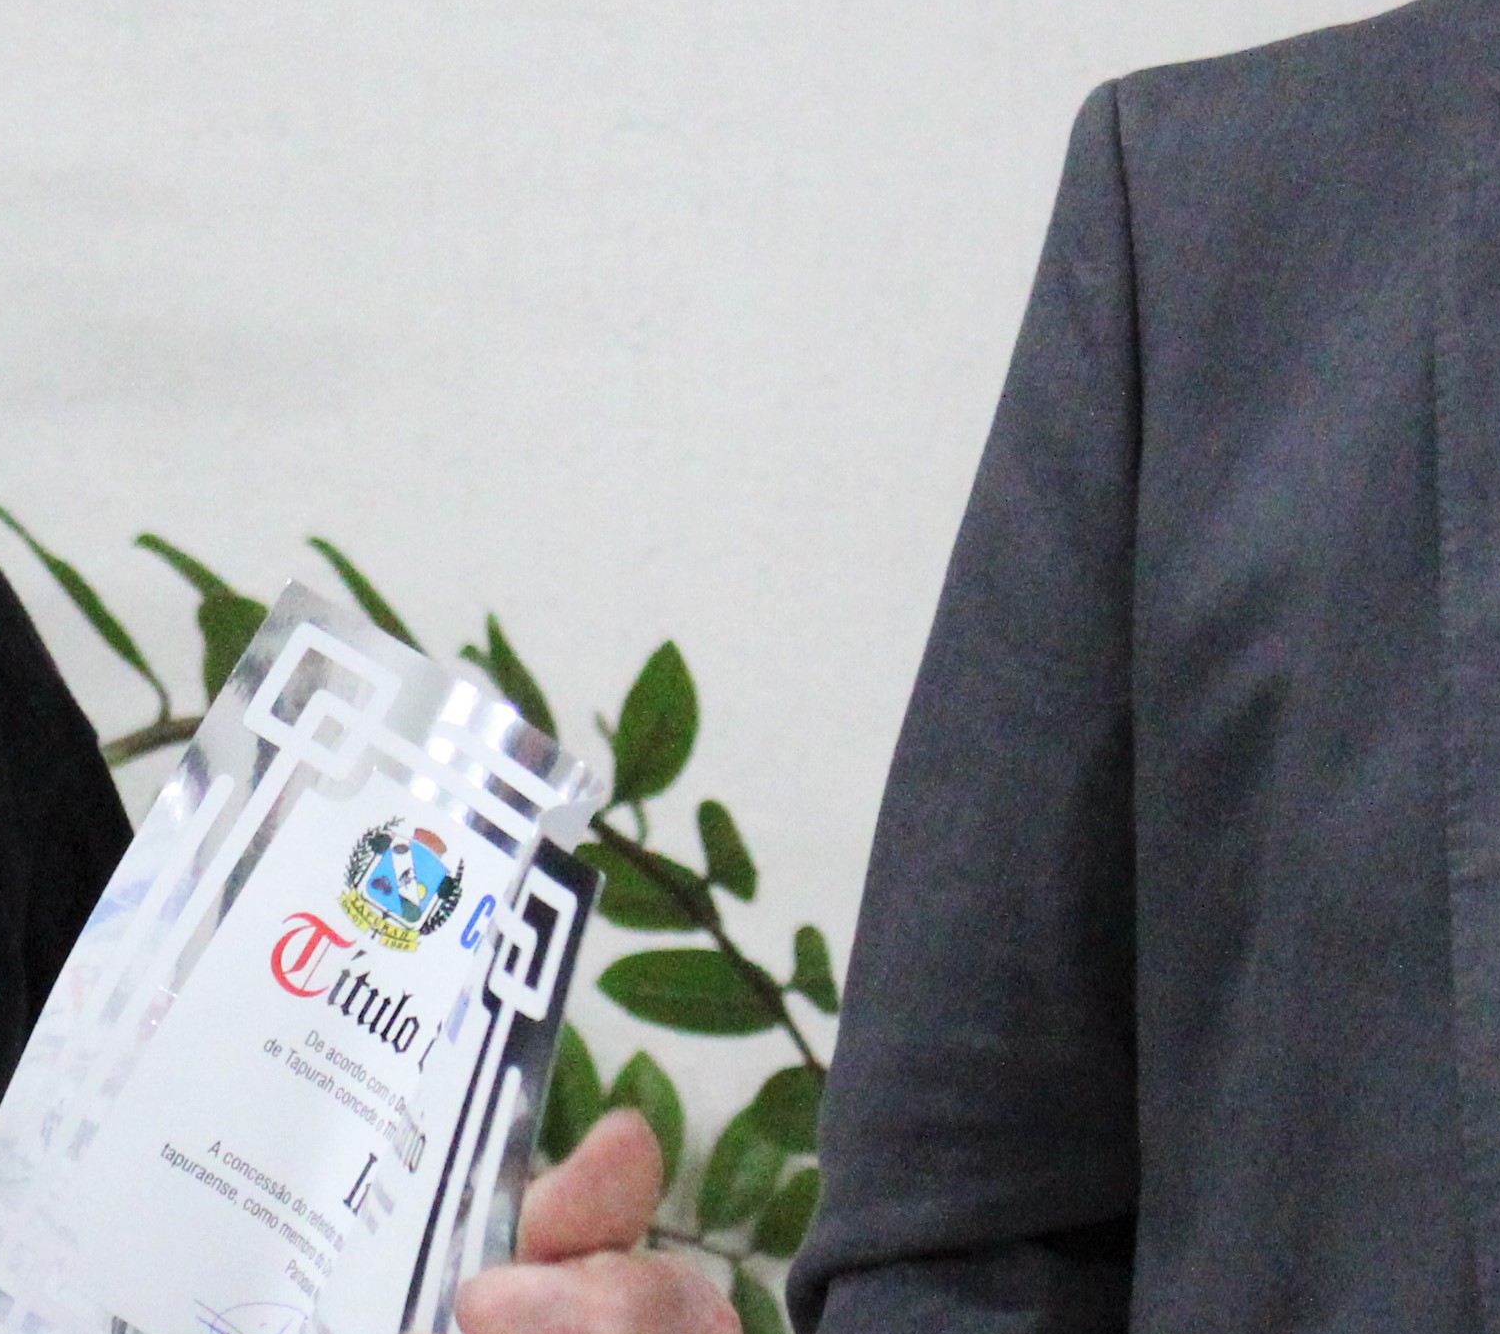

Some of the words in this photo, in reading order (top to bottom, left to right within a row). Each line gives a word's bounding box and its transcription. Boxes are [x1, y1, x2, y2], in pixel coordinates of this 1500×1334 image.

[270, 912, 420, 1054] Título
[263, 1038, 283, 1058] de
[285, 1048, 335, 1094] Tapurah
[335, 1087, 378, 1126] concede
[304, 1030, 325, 1053] De
[325, 1046, 367, 1083] acordo
[367, 1076, 389, 1102] com
[160, 1142, 239, 1205] tapuraense,
[243, 1197, 280, 1230] como
[208, 1140, 221, 1159] A
[222, 1151, 292, 1206] concessão
